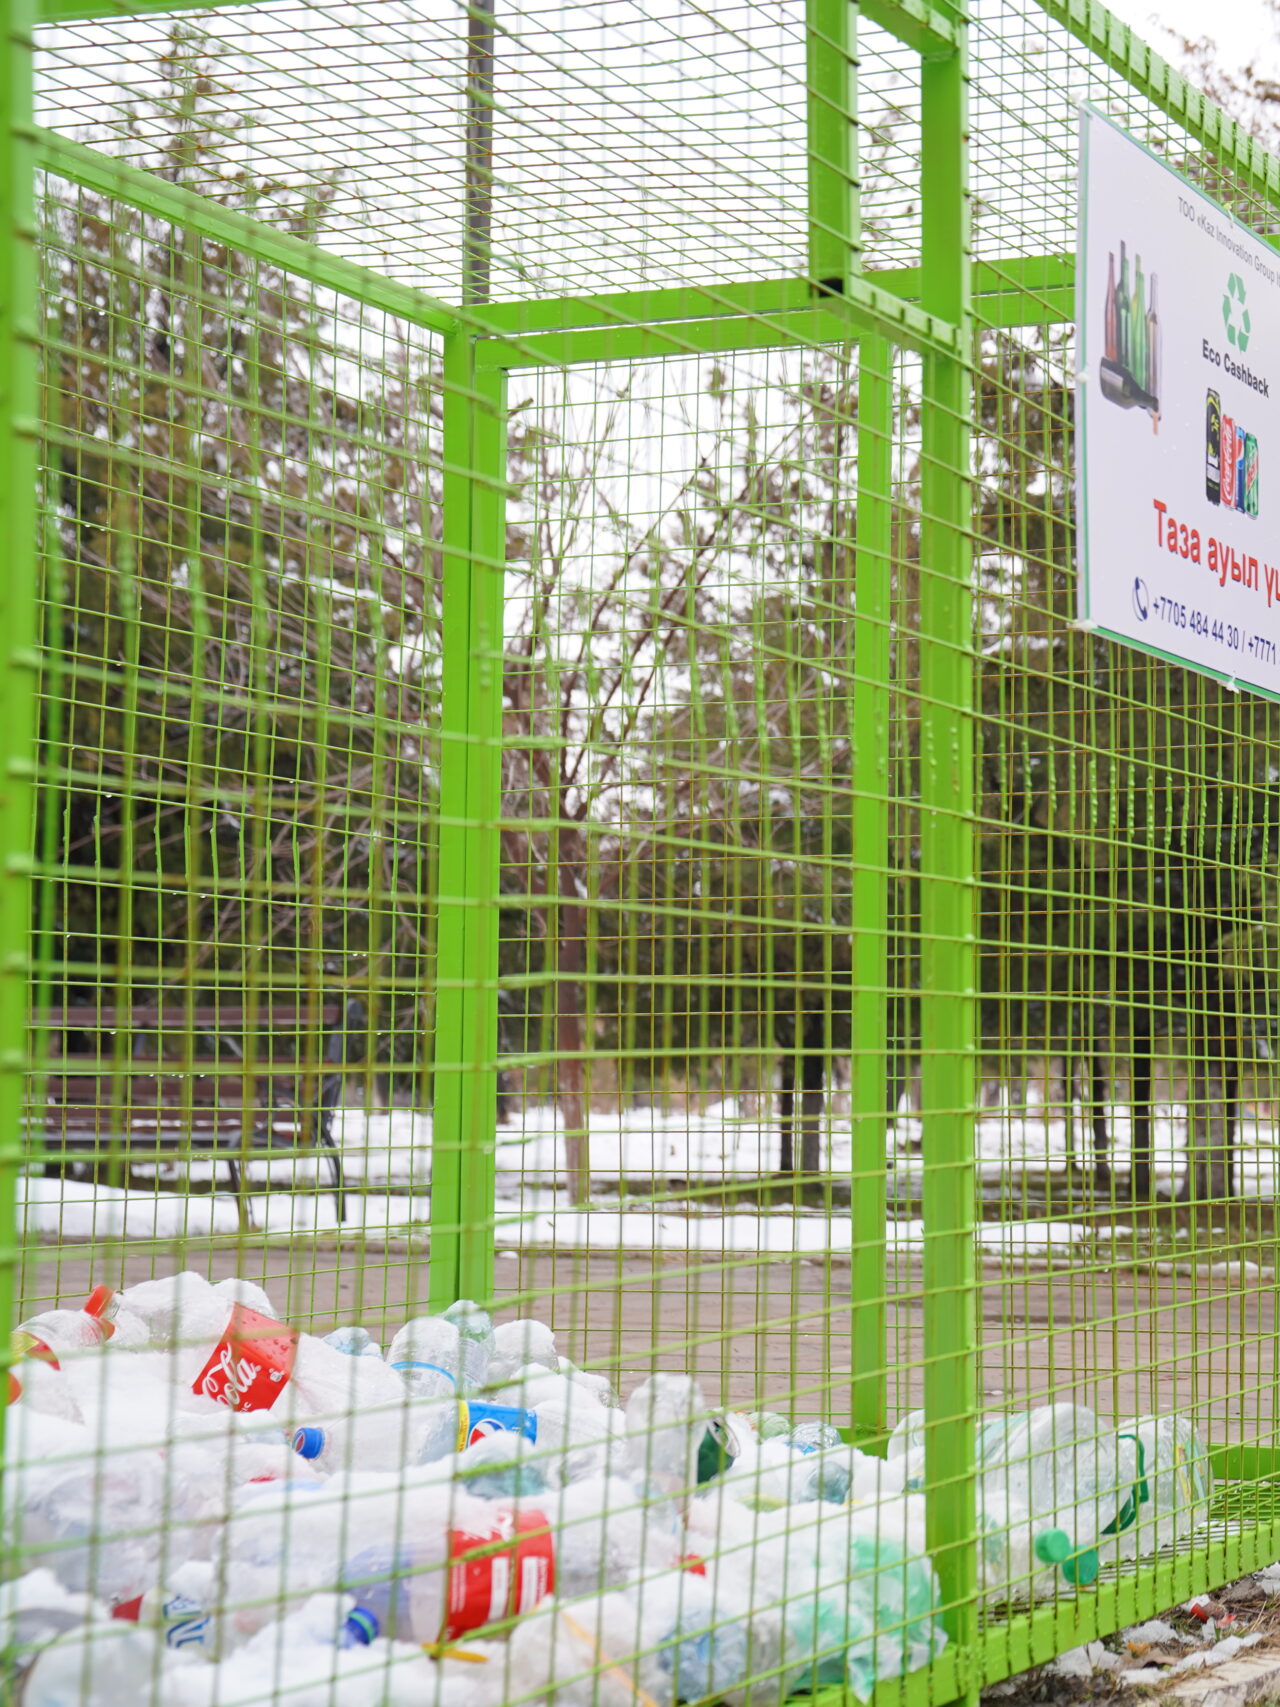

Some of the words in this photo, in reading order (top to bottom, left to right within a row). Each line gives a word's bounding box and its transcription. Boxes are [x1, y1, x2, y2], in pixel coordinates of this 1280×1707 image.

[1216, 225, 1253, 266] Innovation
[1254, 255, 1275, 285] Group
[1202, 338, 1221, 367] Eco
[1224, 355, 1269, 398] Cashback
[1153, 498, 1201, 565] Таза
[1207, 537, 1258, 590] ауыл
[1153, 596, 1186, 628] +7705
[1190, 610, 1209, 638] 484
[1211, 618, 1224, 644] 44
[1227, 624, 1239, 651] 30
[1248, 635, 1276, 665] +7771
